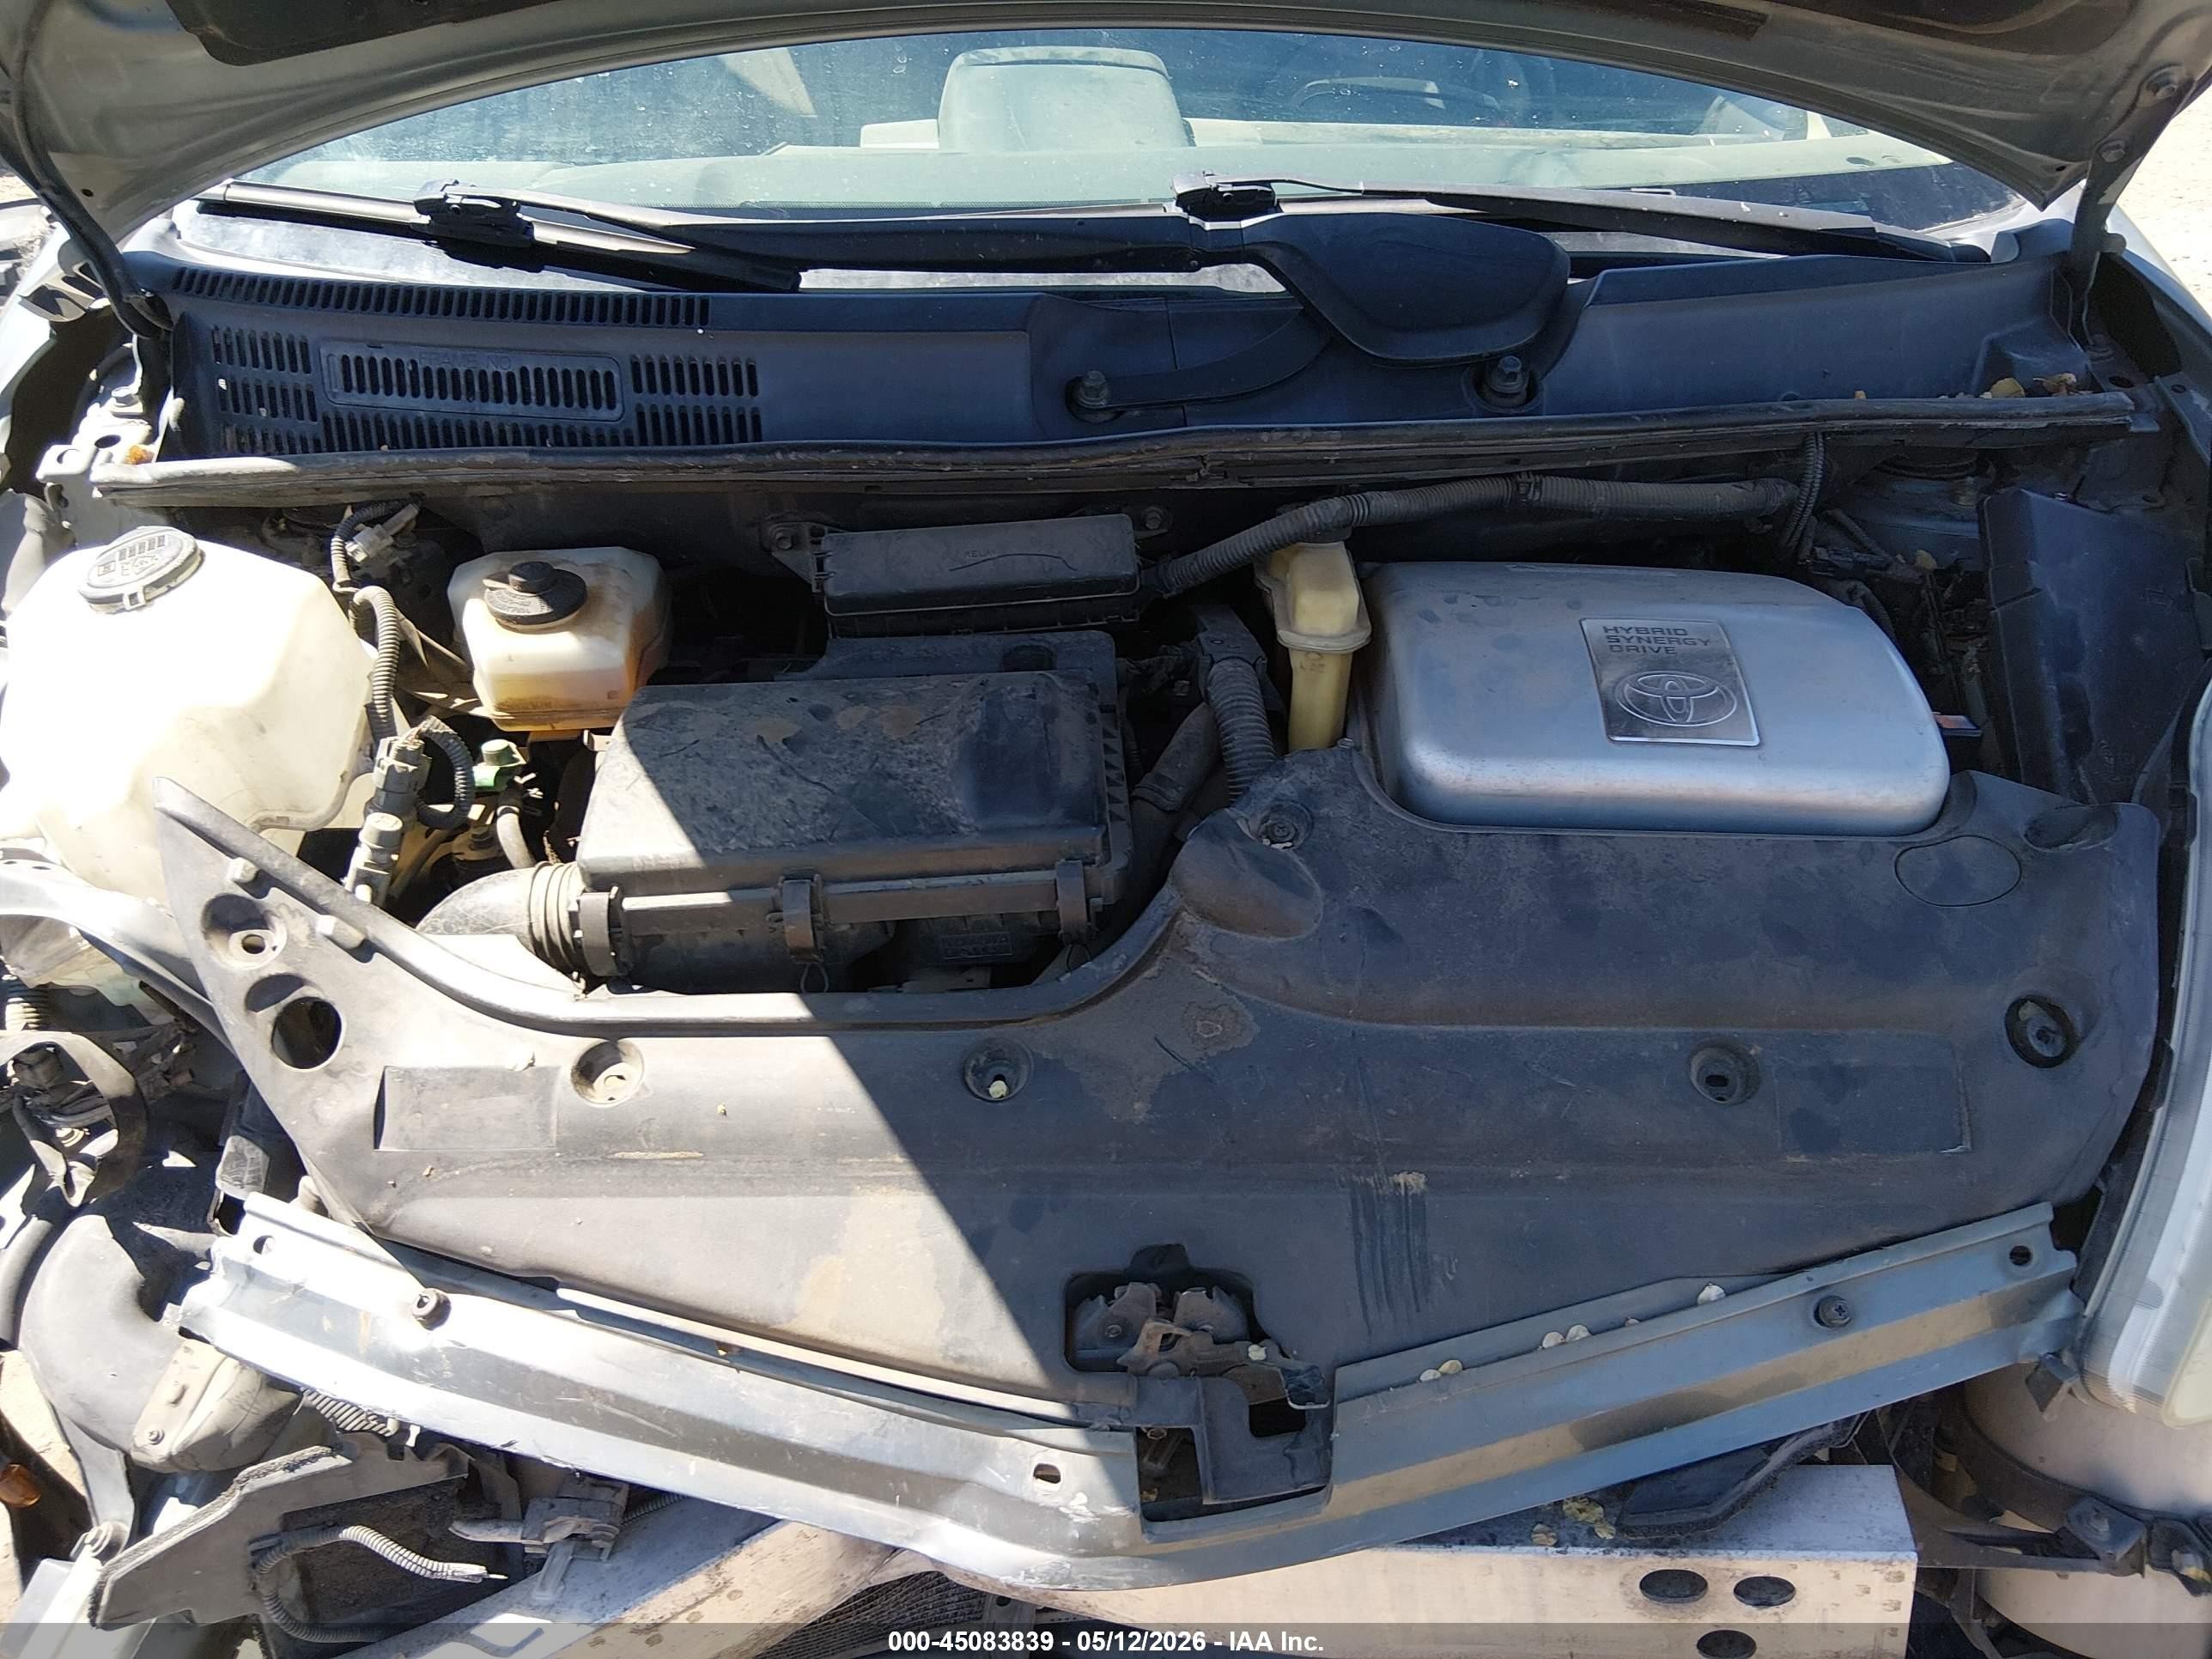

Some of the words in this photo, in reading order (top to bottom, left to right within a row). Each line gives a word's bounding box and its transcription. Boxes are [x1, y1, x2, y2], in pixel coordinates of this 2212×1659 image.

[962, 549, 997, 558] RELAY
[1602, 625, 1689, 636] HYBRID
[1606, 635, 1711, 647] SYNERGY
[1608, 644, 1678, 655] DRIVE
